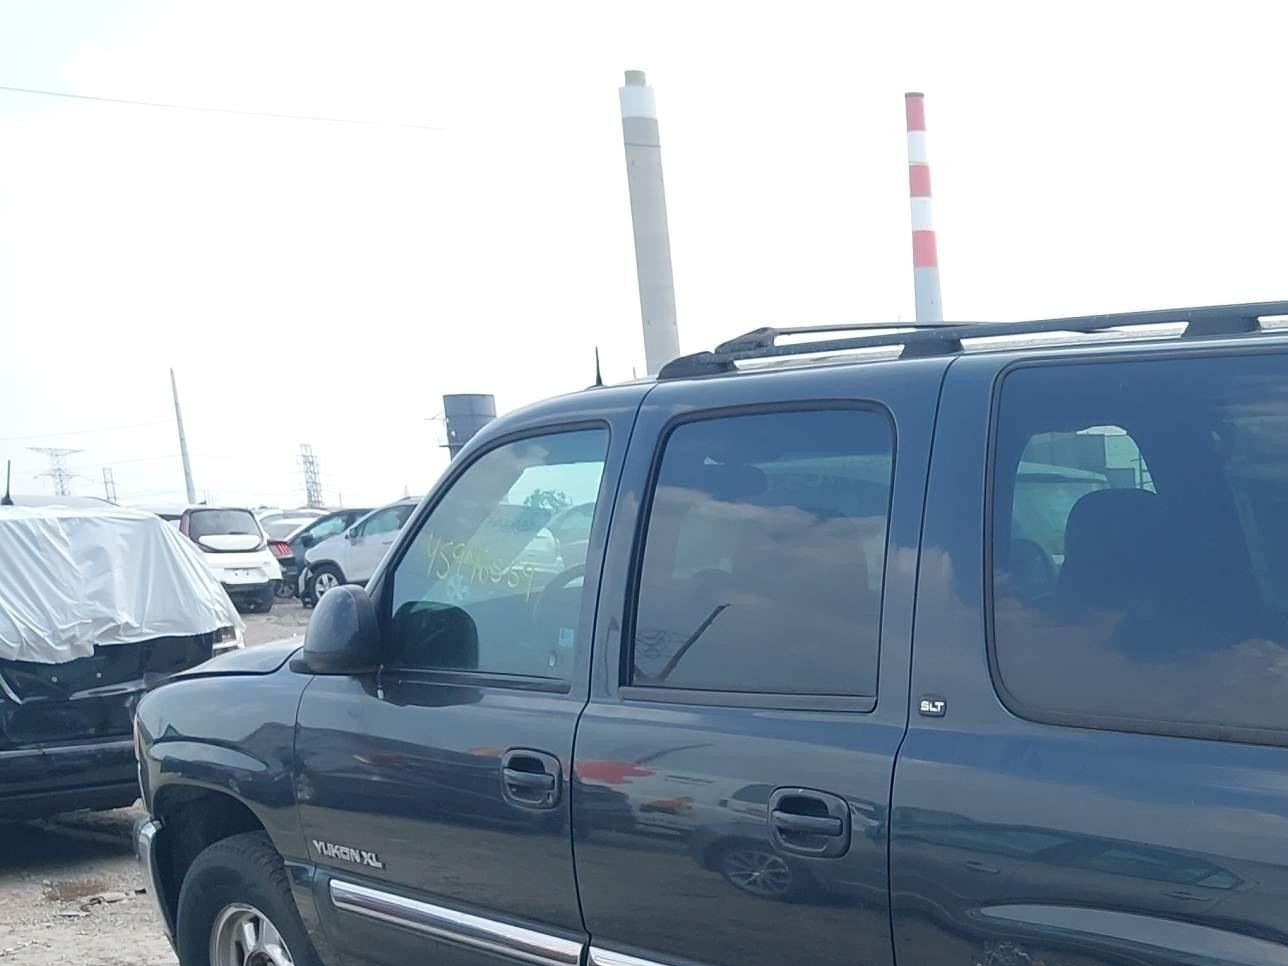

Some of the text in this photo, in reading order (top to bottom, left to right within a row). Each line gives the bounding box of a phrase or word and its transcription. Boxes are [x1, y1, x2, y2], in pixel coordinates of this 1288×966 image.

[920, 700, 945, 712] SLT
[312, 839, 383, 869] YUKON XL
